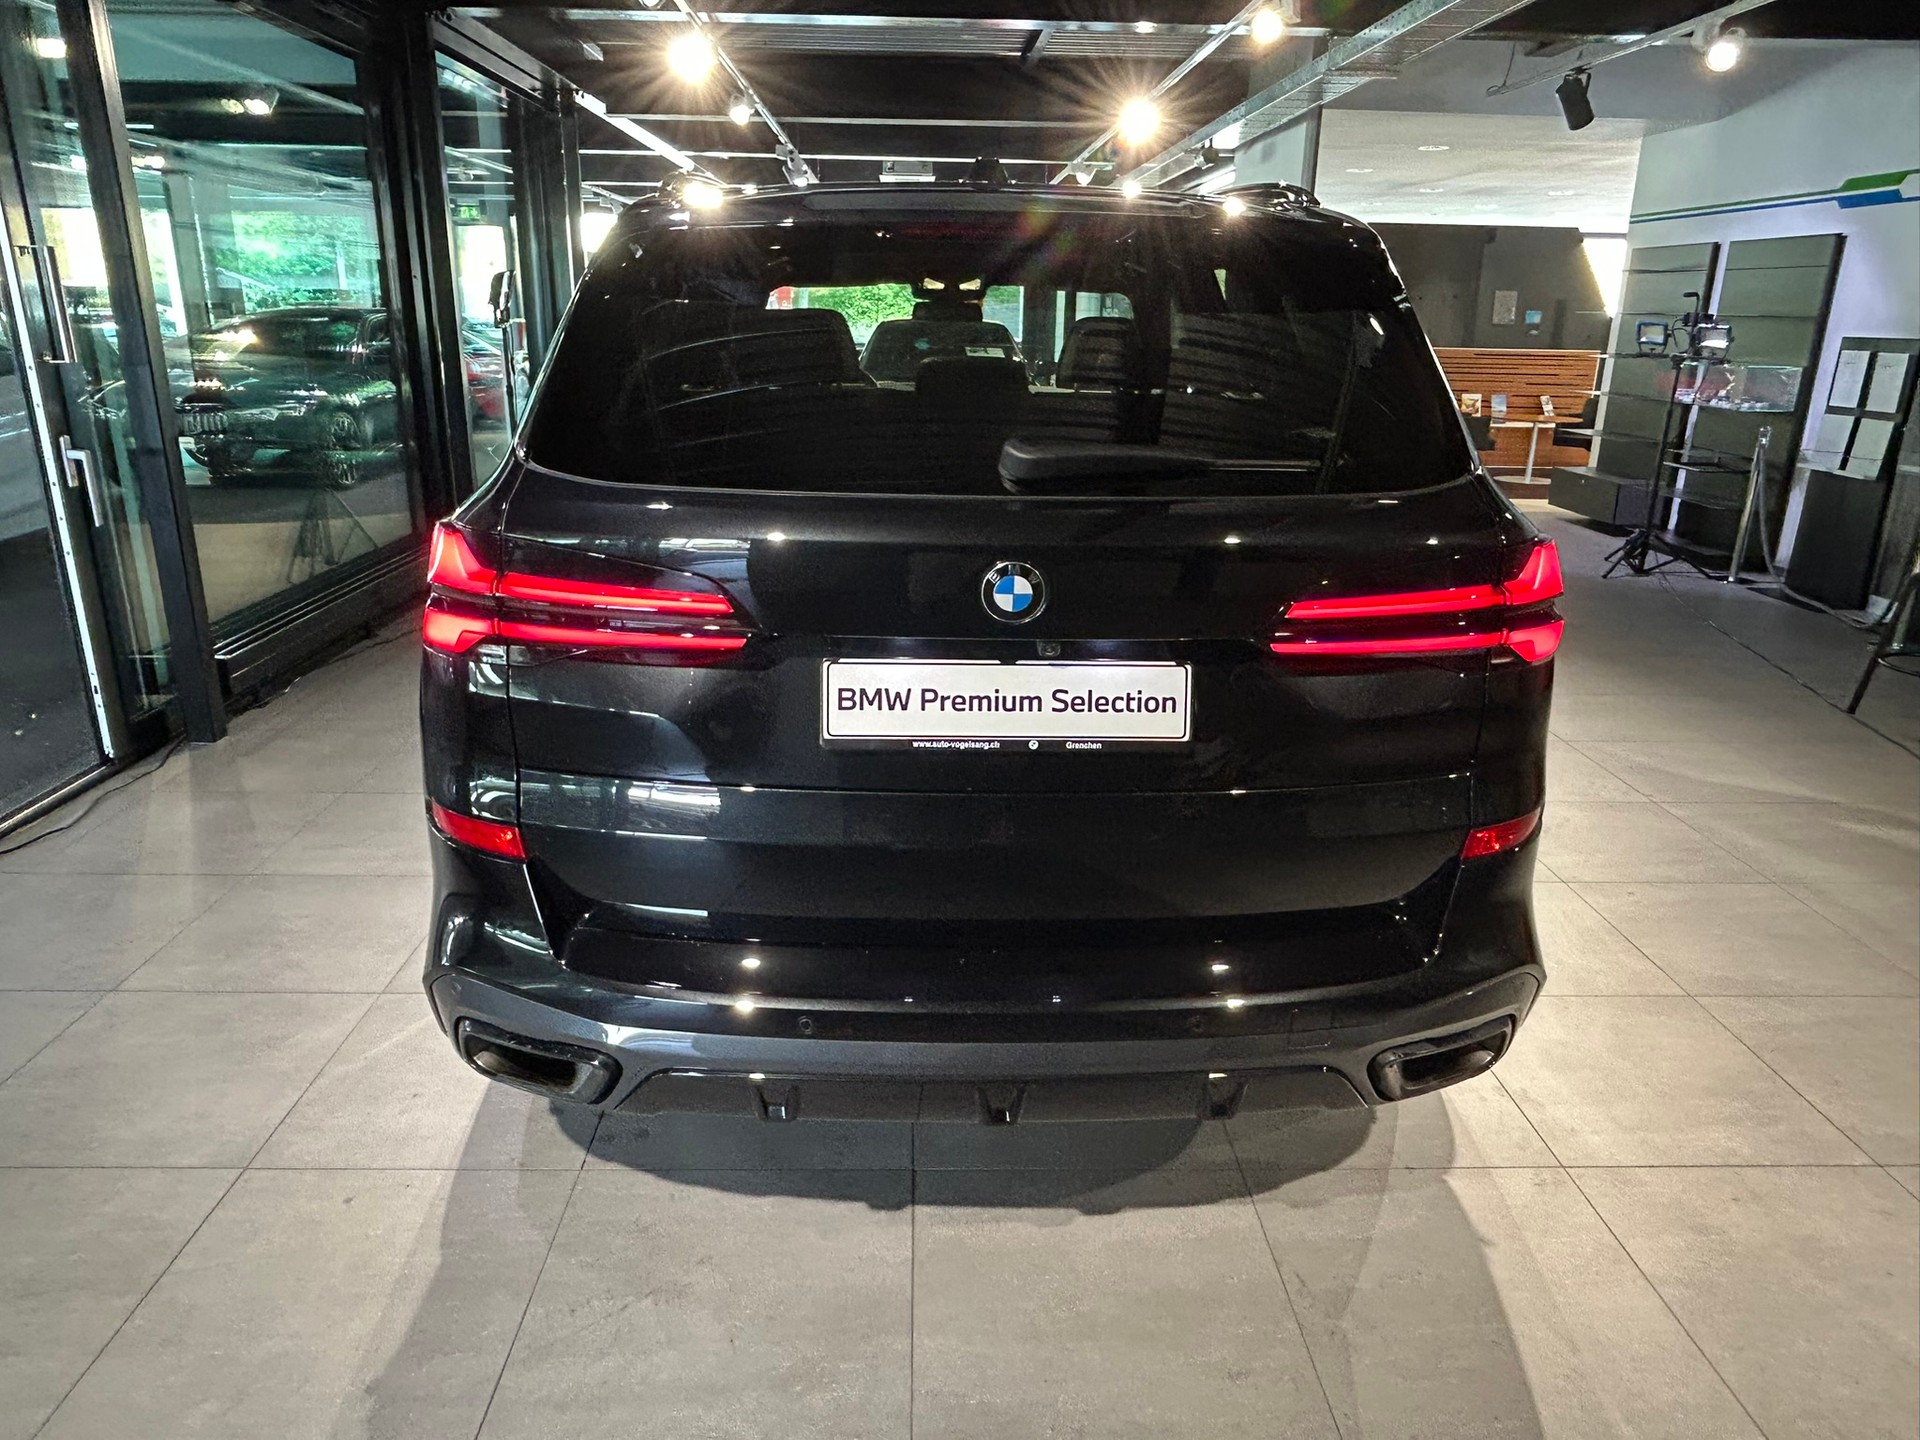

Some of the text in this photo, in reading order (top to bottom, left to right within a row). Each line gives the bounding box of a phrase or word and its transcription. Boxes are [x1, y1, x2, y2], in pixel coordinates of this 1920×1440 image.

[837, 687, 1177, 714] BMW Premium Selection
[912, 740, 1102, 750] www.auto-vogelsang.ch Grenchen
